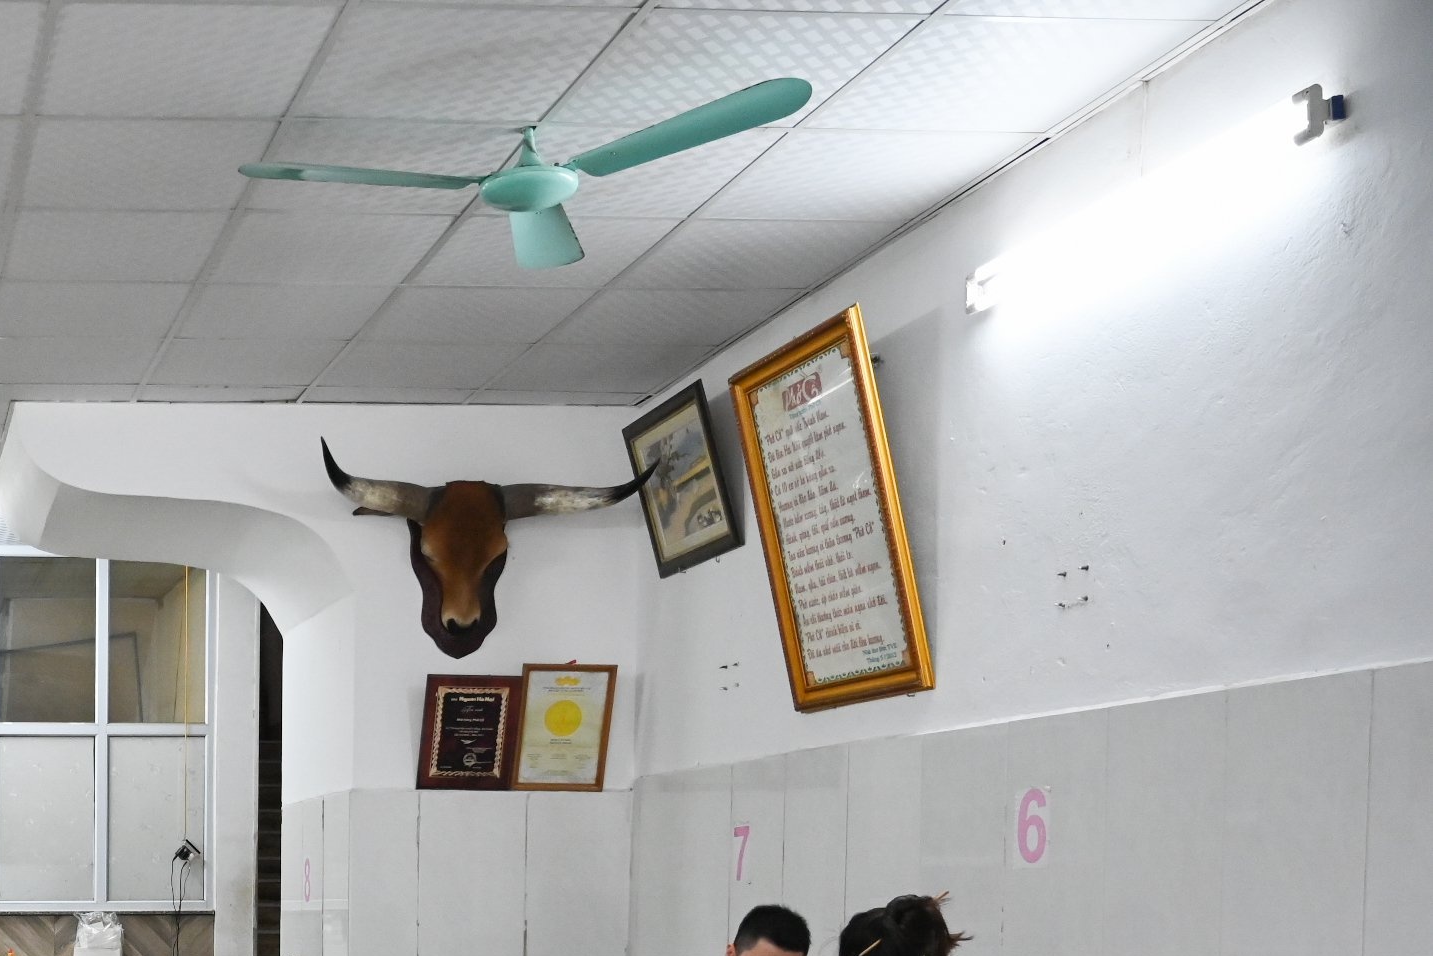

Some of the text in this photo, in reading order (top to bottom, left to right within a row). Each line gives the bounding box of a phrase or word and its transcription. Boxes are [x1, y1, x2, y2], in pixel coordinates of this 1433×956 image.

[733, 825, 750, 882] 7
[1017, 788, 1047, 864] 6
[304, 857, 311, 903] 8
